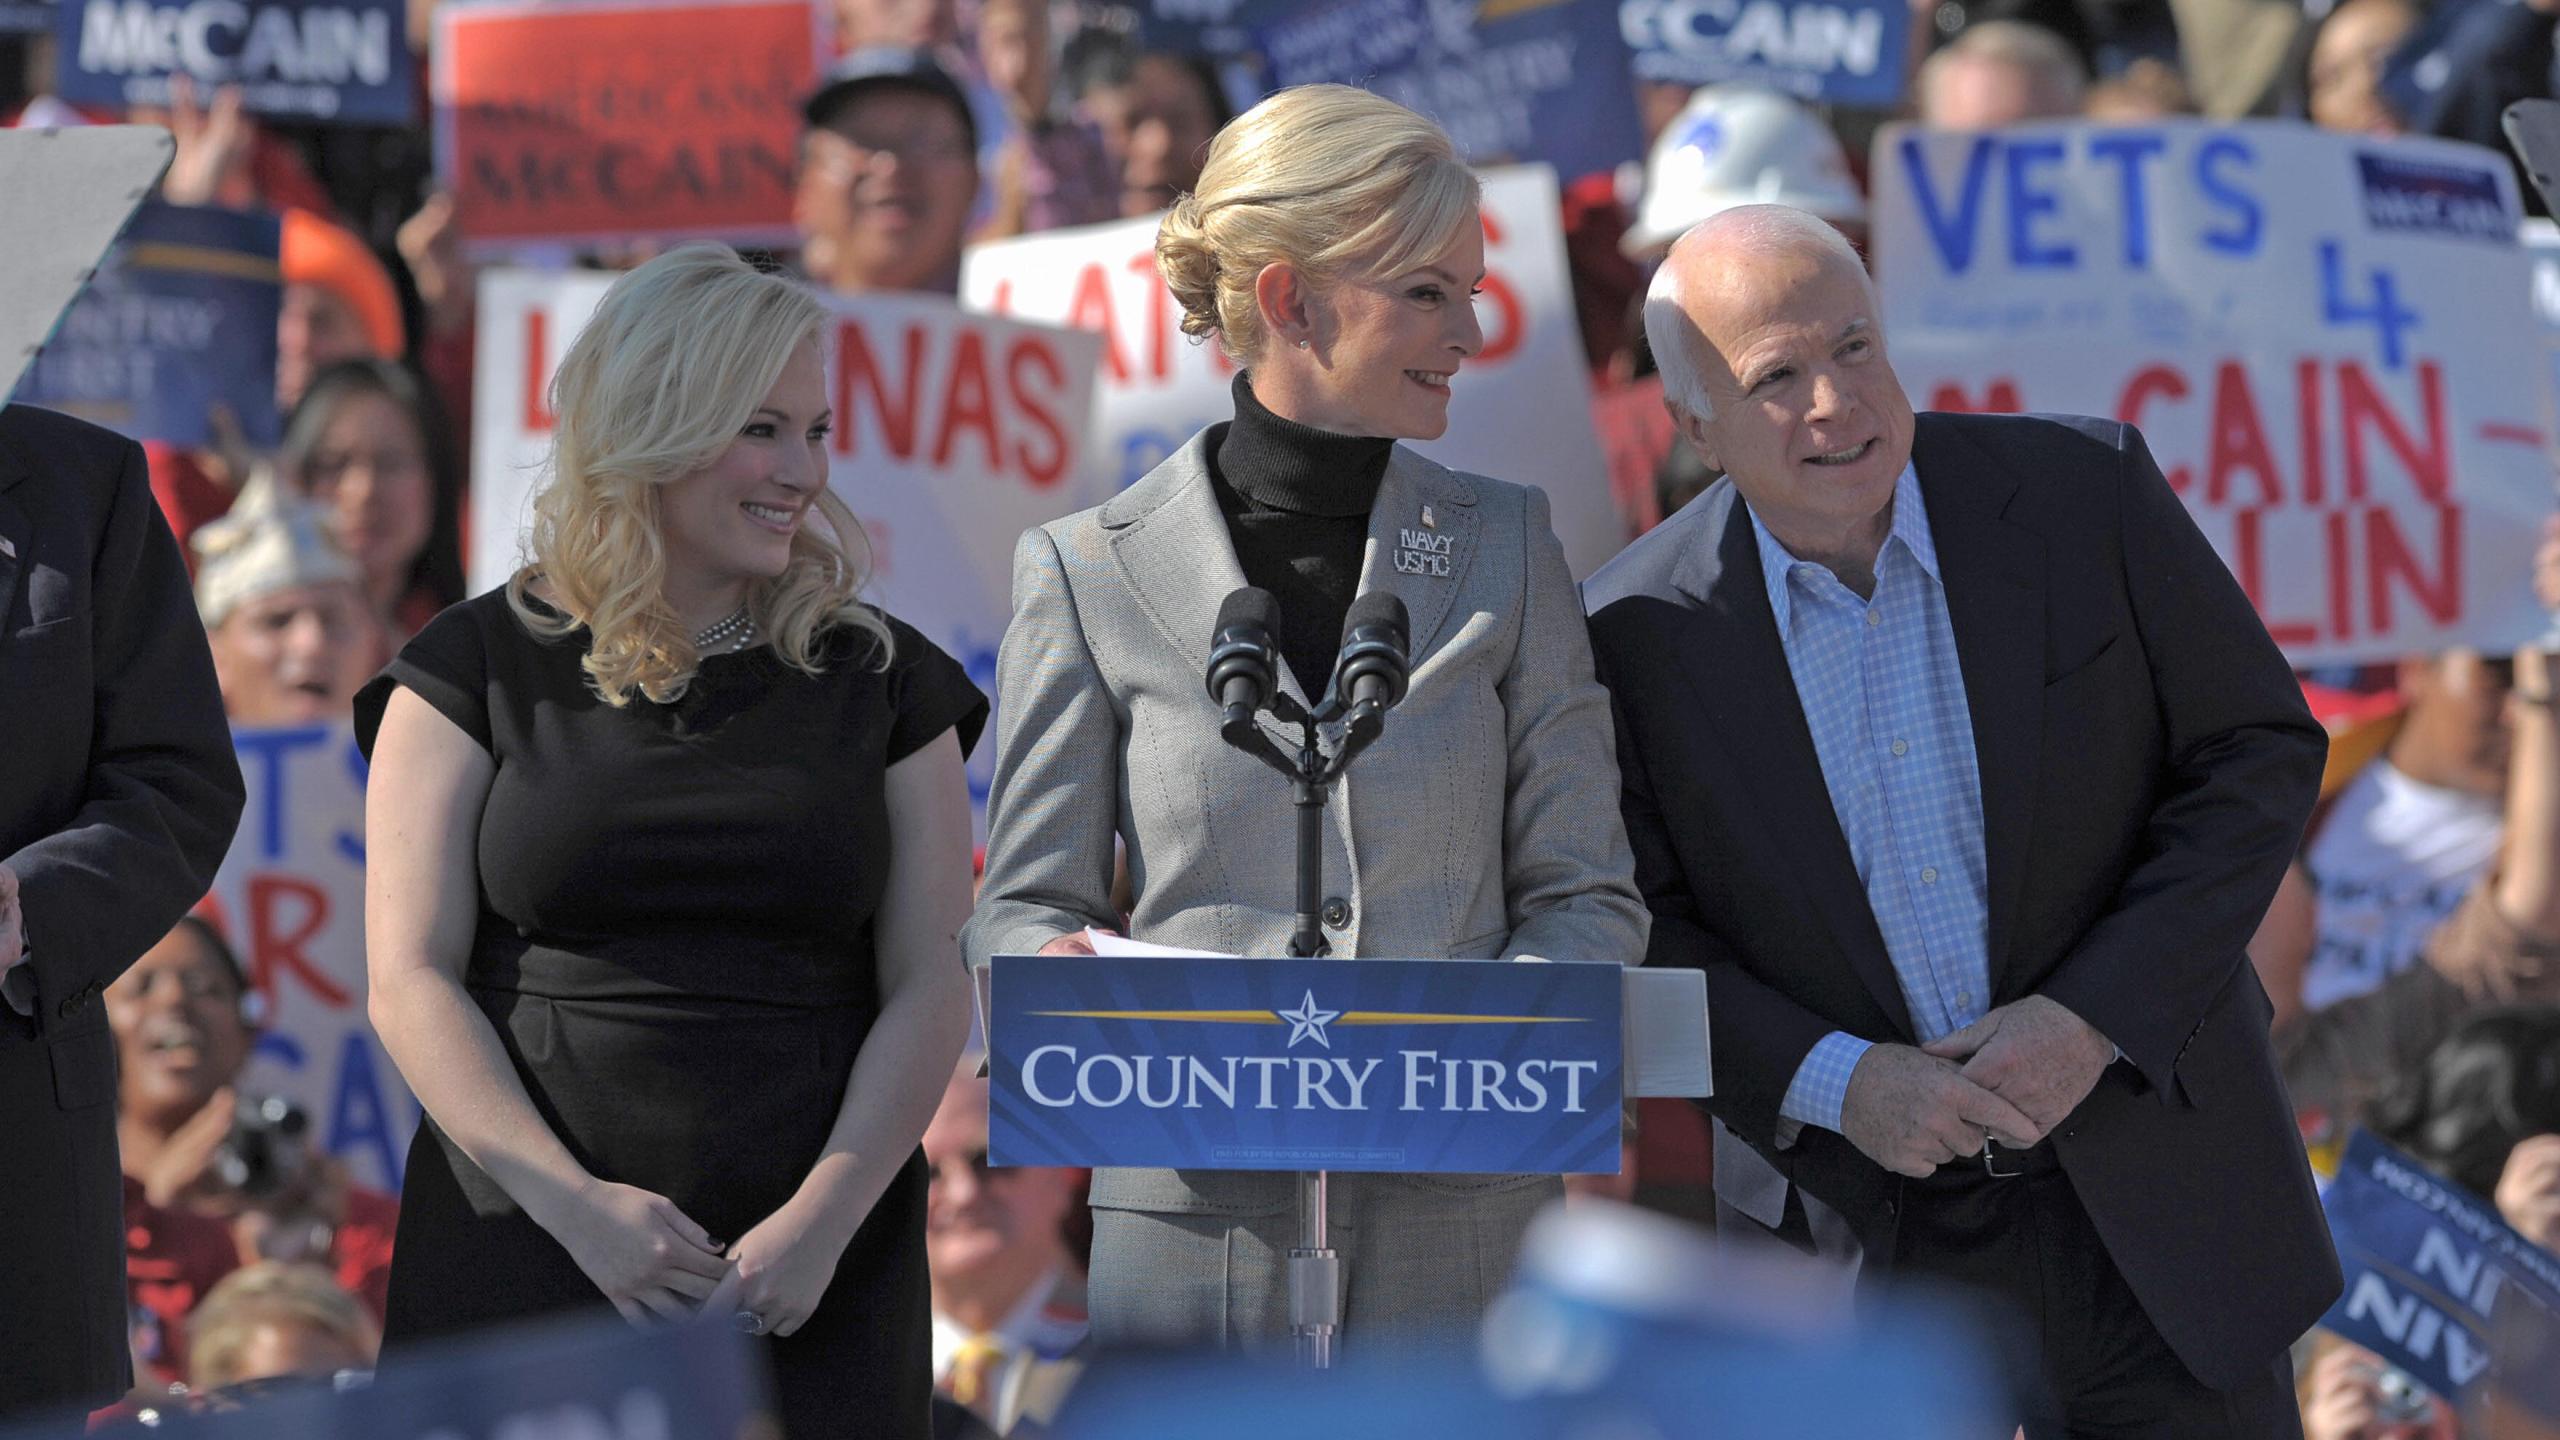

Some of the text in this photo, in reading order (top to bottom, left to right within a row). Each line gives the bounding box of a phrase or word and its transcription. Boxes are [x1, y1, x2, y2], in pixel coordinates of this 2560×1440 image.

[1618, 0, 1883, 76] cCAIN
[1903, 136, 2266, 275] VETS
[2317, 240, 2422, 371] 4
[524, 308, 1072, 492] LNAS
[1394, 549, 1450, 577] USMC
[1401, 528, 1454, 555] NAVY
[2232, 504, 2465, 646] LIN
[1020, 1043, 1598, 1114] COUNTRY FIRST
